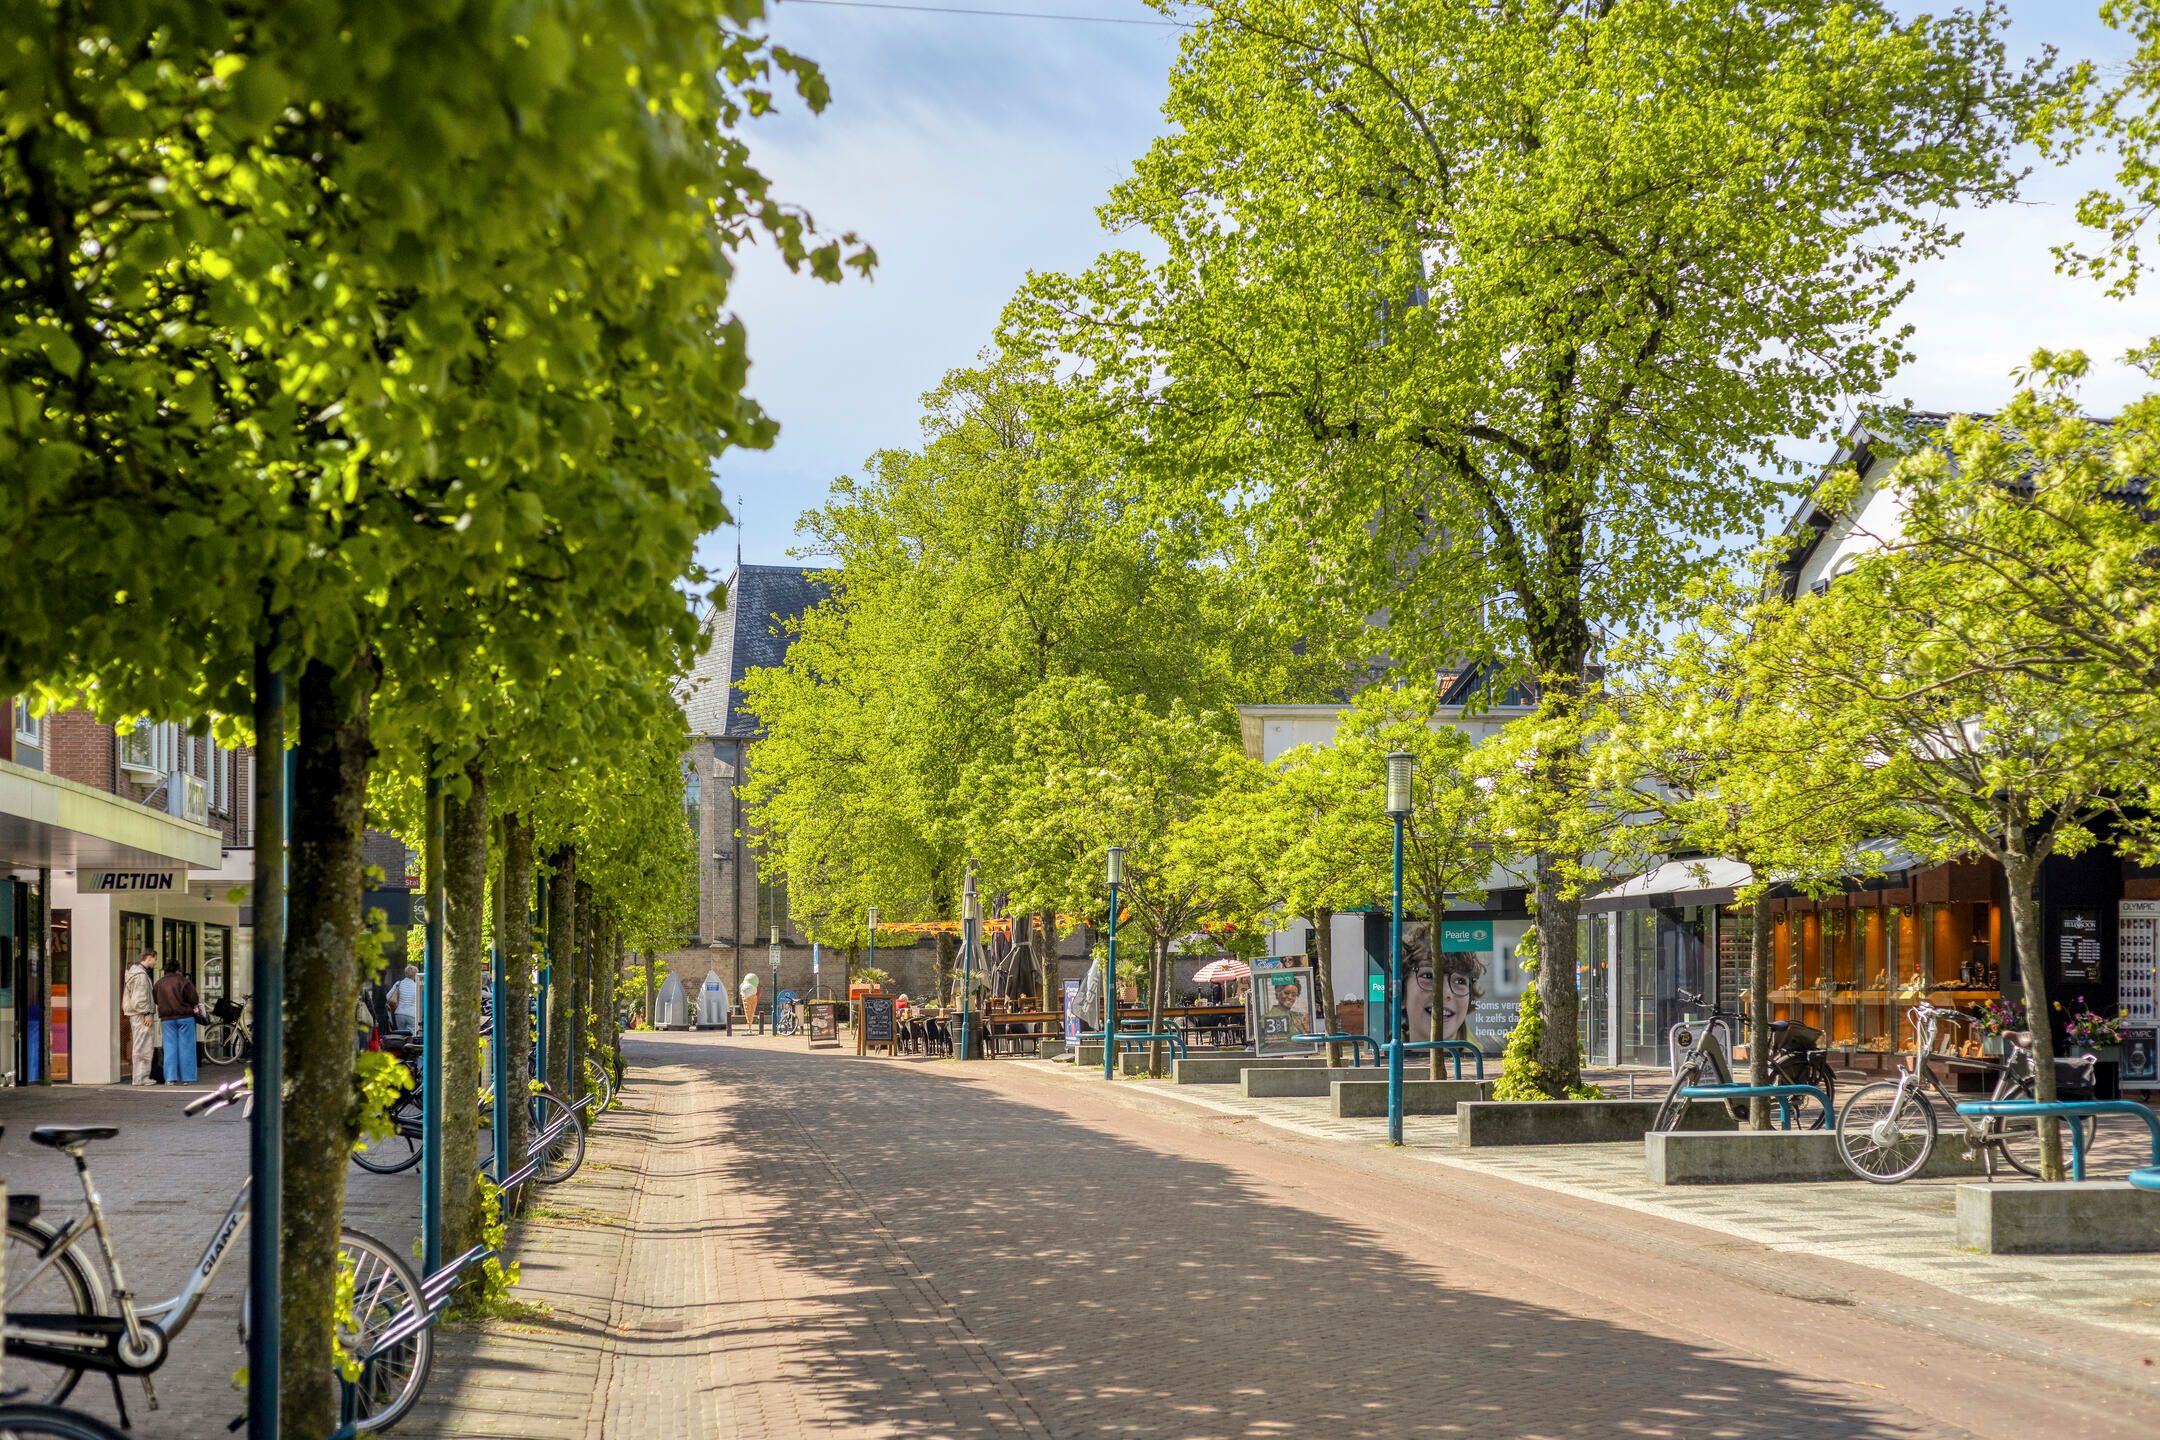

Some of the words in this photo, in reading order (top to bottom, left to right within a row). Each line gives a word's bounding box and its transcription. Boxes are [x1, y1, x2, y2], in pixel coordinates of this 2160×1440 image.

[101, 873, 173, 889] ACTION
[2122, 902, 2155, 911] OLYMPIC
[1445, 930, 1470, 939] Pearle
[1475, 1013, 1484, 1023] ik
[1486, 1012, 1506, 1023] zelfs
[1266, 1018, 1276, 1033] 3
[1475, 1026, 1495, 1036] hem
[202, 1213, 237, 1277] GIANT
